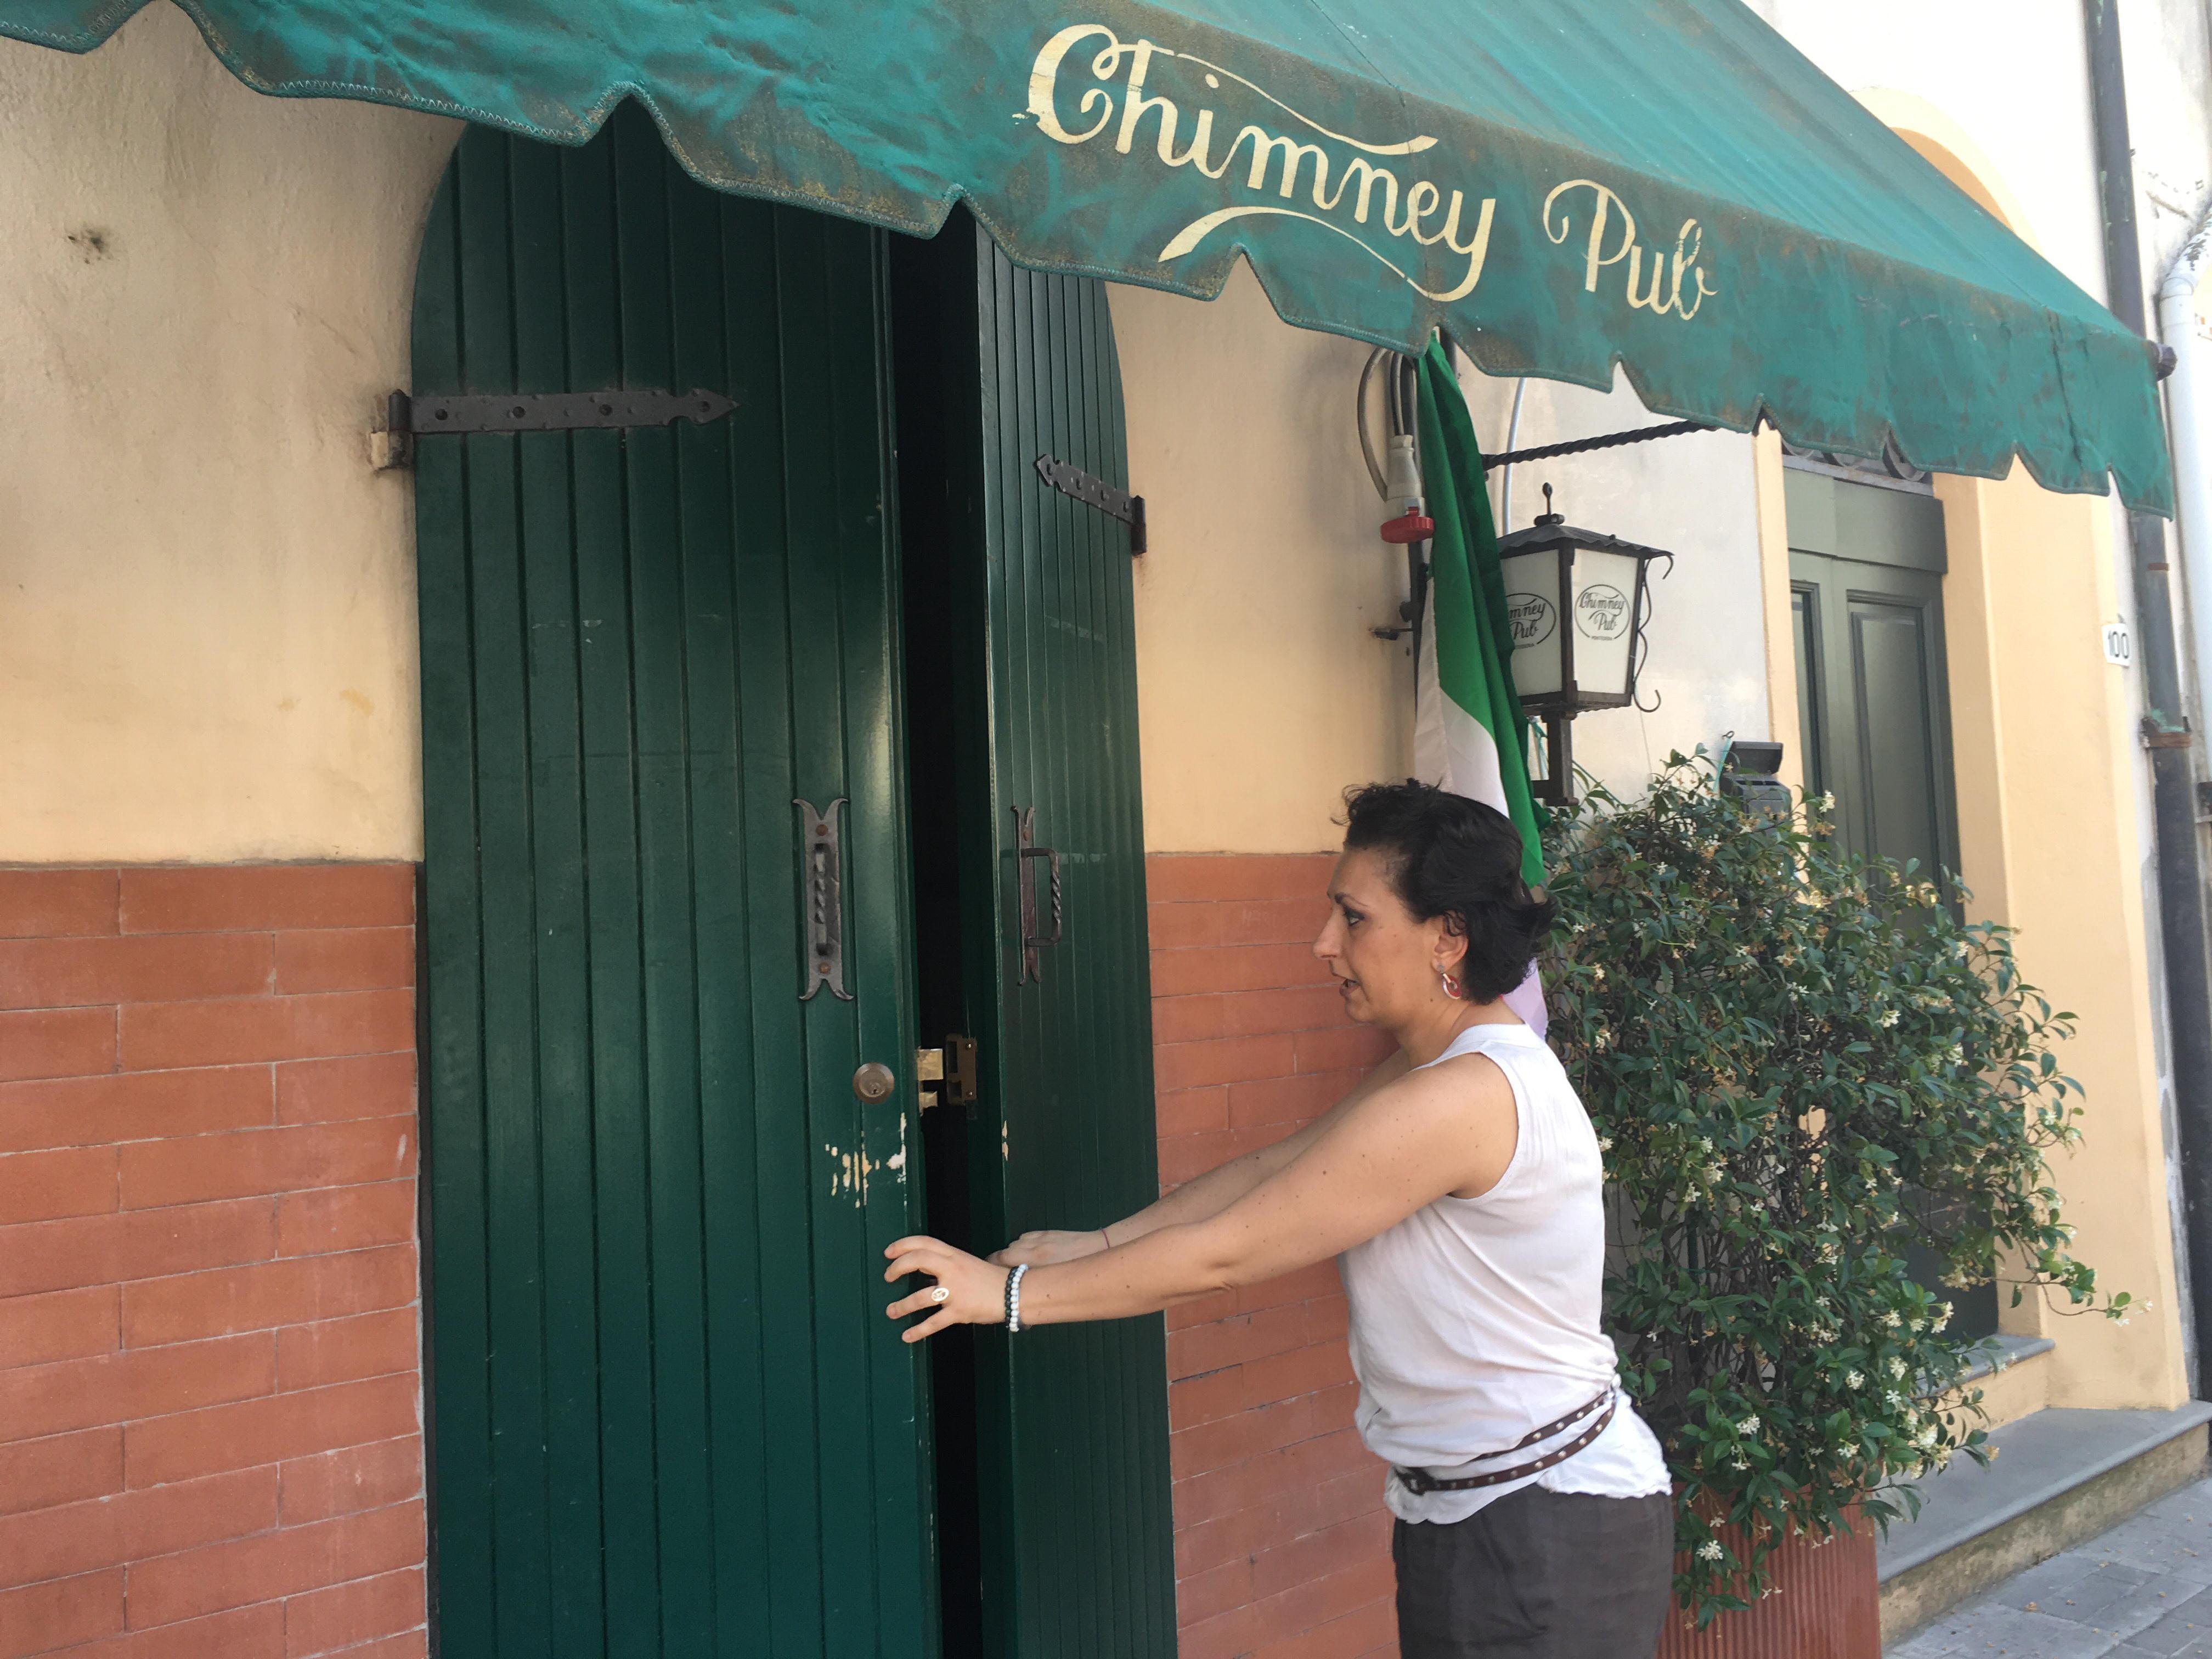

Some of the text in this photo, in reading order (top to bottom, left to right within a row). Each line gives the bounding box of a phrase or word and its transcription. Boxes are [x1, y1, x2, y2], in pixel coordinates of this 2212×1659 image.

[1027, 24, 1718, 320] Chimney Pub
[1508, 602, 1546, 622] mney
[1579, 592, 1625, 617] Chimney
[1510, 621, 1539, 640] Pub
[1593, 612, 1618, 630] Pub
[2107, 630, 2130, 659] 100
